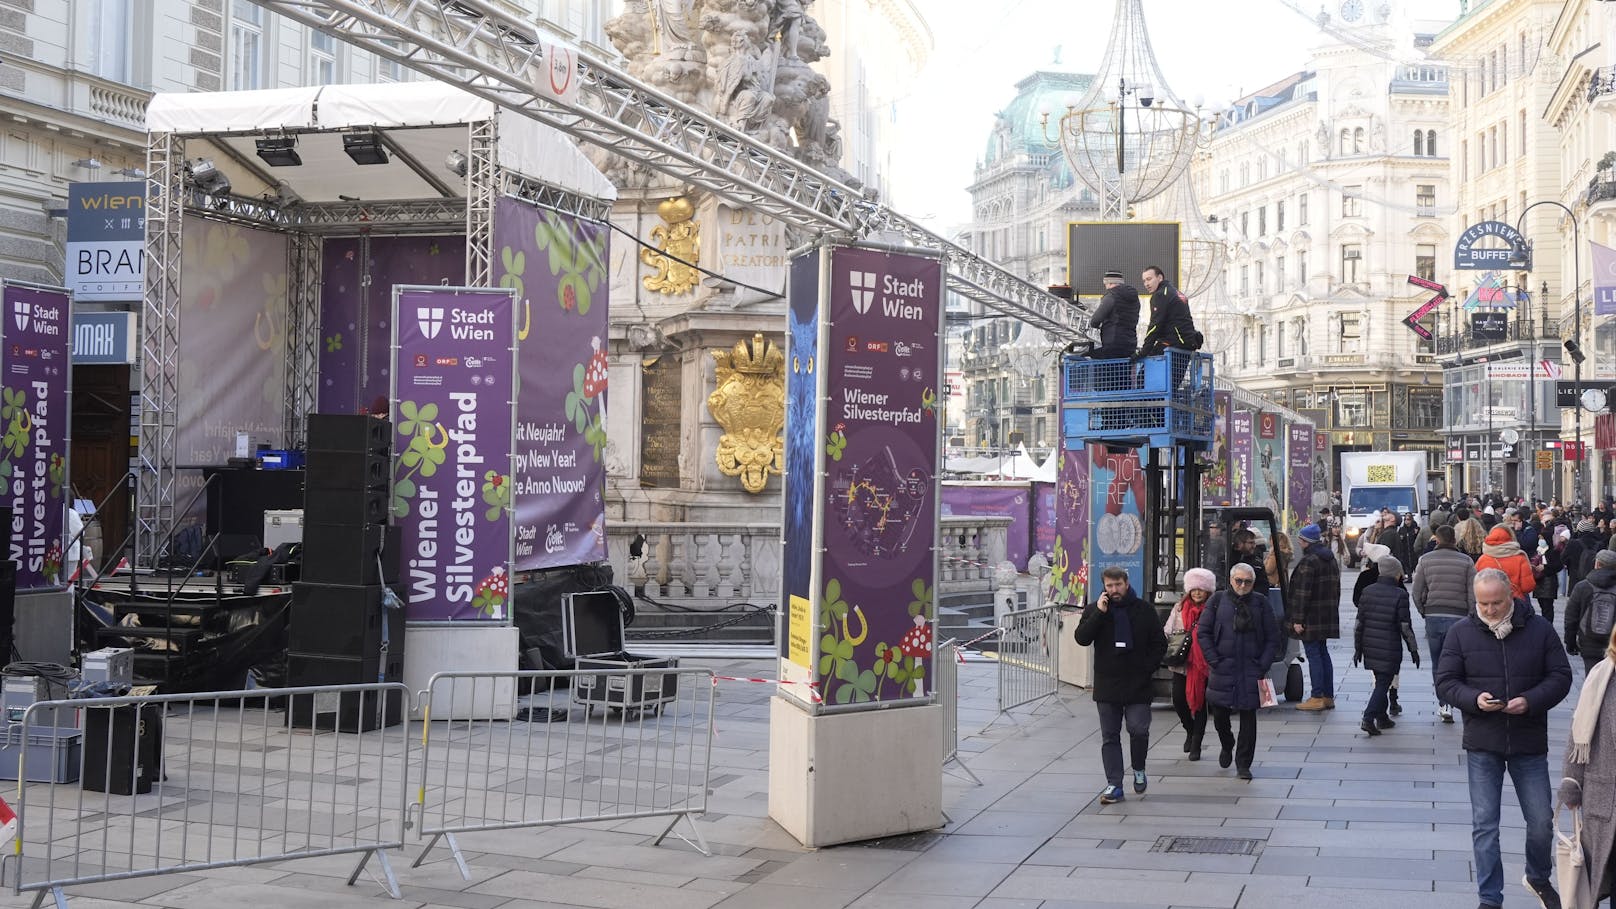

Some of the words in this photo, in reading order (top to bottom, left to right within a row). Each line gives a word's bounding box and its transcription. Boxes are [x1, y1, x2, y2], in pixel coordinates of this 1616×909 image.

[730, 208, 773, 225] DEO
[725, 233, 779, 247] PATRI
[883, 274, 924, 299] Stadt
[33, 304, 59, 321] Stadt
[451, 308, 495, 324] Stadt
[882, 297, 923, 321] Wien
[33, 319, 59, 336] Wien
[450, 325, 494, 340] Wien
[844, 388, 889, 406] Wiener
[843, 404, 922, 426] Silvesterpfad
[526, 422, 566, 447] Neujahr!
[529, 449, 551, 467] New
[551, 449, 577, 468] Year!
[29, 381, 51, 572] Silvesterpfad
[1106, 458, 1144, 481] DICH
[525, 476, 551, 495] Anno
[552, 475, 586, 494] Nuovo!
[1096, 481, 1132, 505] FREI
[446, 392, 484, 602] Silvesterpfad
[8, 466, 25, 571] Wiener
[518, 524, 537, 541] Stadt
[409, 485, 439, 603] Wiener
[516, 542, 533, 557] Wien
